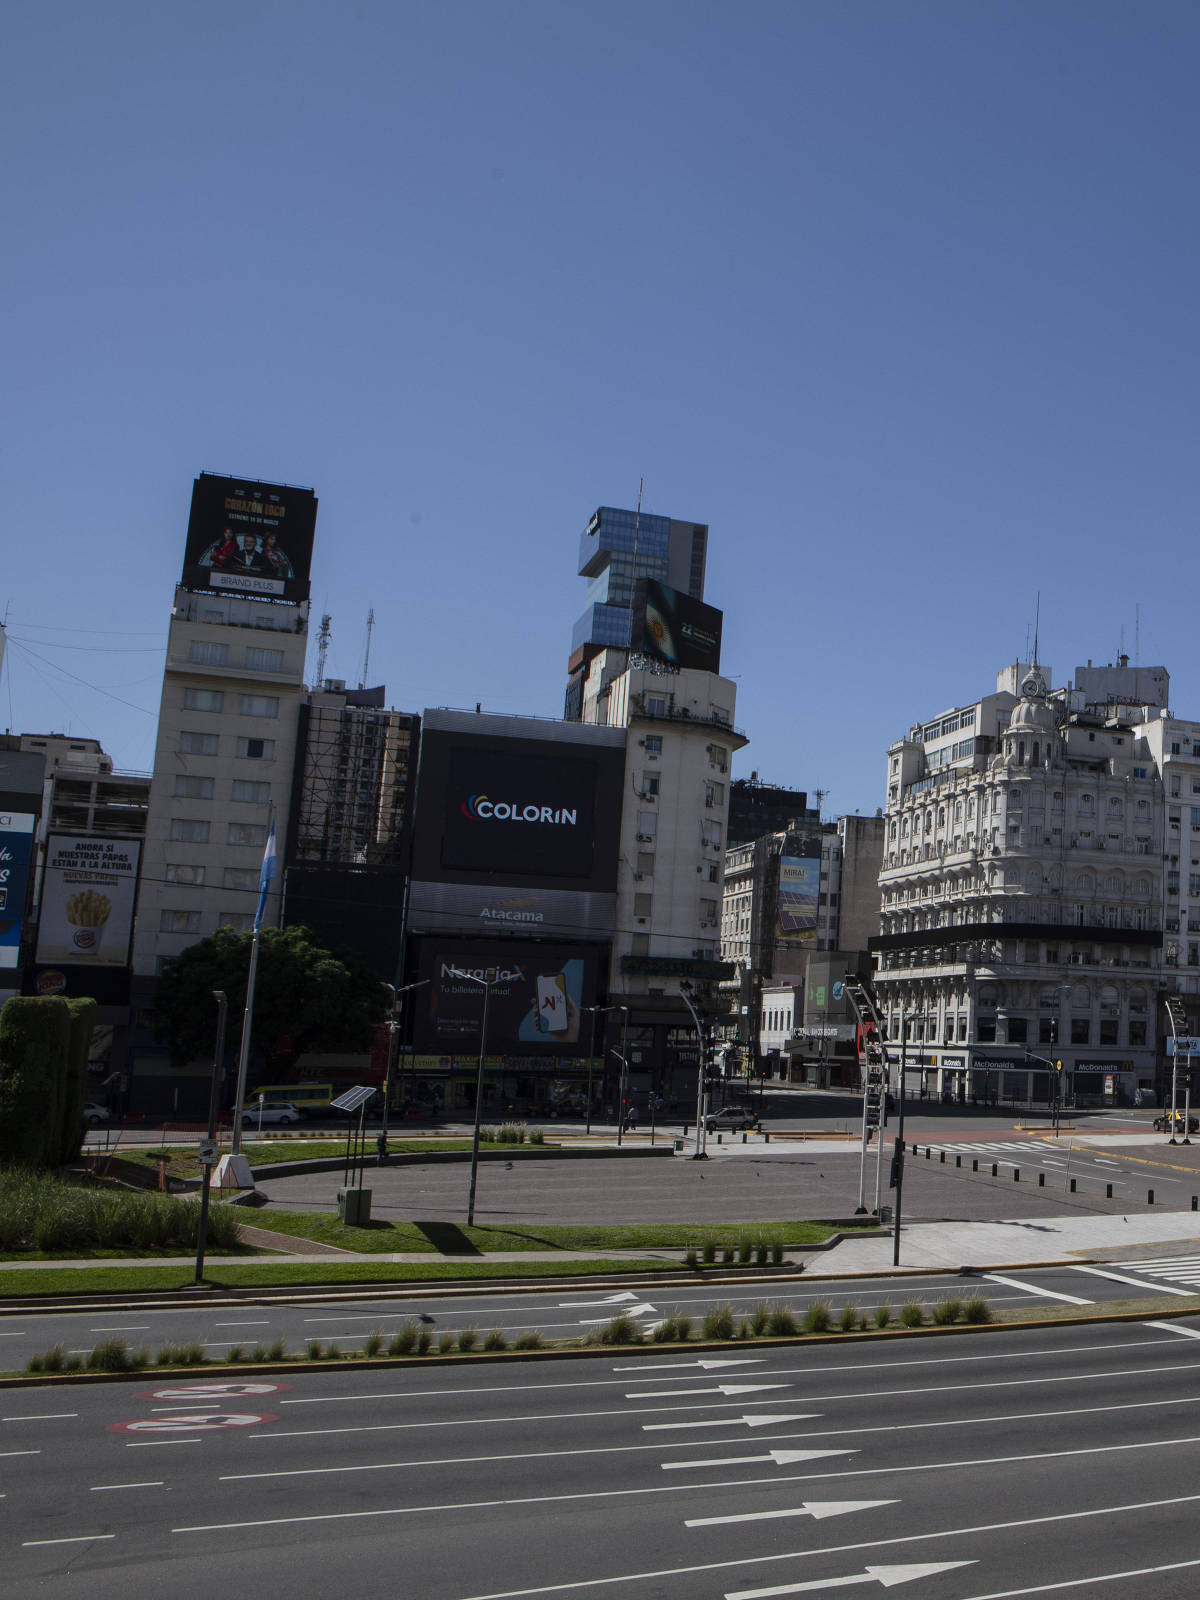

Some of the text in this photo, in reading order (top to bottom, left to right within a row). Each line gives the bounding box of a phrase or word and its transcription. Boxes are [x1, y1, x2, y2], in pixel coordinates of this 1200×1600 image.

[220, 576, 275, 590] BRAND PLUS
[75, 843, 103, 852] AHORA
[58, 851, 129, 862] NUESTRAS PAPAS
[89, 861, 99, 869] LA
[102, 862, 133, 871] ALTURA
[479, 907, 544, 922] Atacama
[973, 1059, 1015, 1070] McDonald's
[1078, 1063, 1118, 1072] McDonald's
